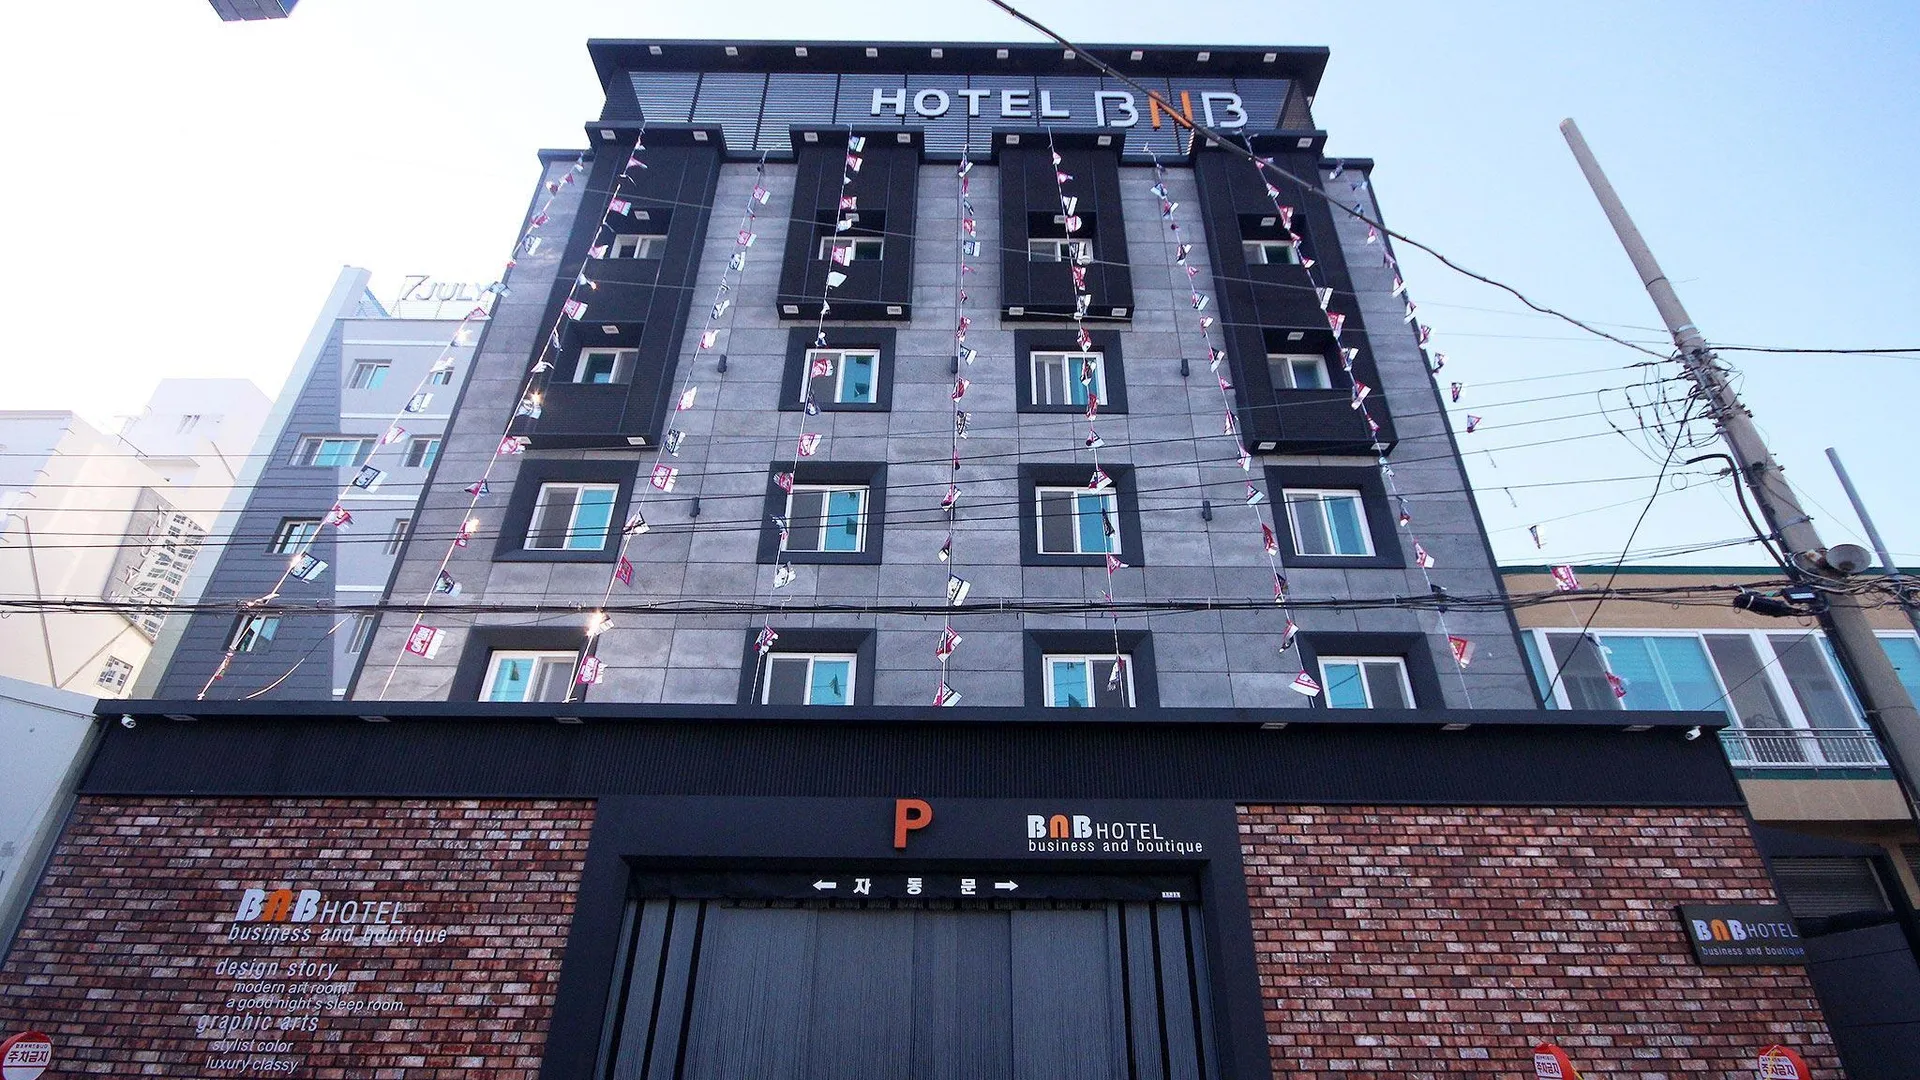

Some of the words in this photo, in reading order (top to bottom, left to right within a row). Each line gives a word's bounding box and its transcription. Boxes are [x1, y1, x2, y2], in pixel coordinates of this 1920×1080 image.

[870, 88, 1070, 118] HOTEL
[1094, 90, 1248, 129] BNB
[893, 798, 933, 848] P
[1097, 822, 1164, 839] HOTEL
[1028, 839, 1095, 852] business
[1103, 840, 1129, 852] and
[1136, 840, 1203, 854] boutique
[319, 900, 404, 924] HOTEL
[228, 924, 311, 942] business
[320, 926, 355, 942] and
[362, 926, 448, 944] boutique
[1746, 923, 1798, 938] HOTEL
[1702, 946, 1743, 956] business
[1746, 946, 1761, 955] and
[1765, 946, 1805, 956] boutique
[215, 957, 278, 978] design
[288, 960, 338, 979] story
[232, 980, 285, 994] modern
[288, 981, 308, 994] art
[226, 999, 235, 1008] a
[236, 997, 273, 1011] good
[325, 997, 364, 1013] sleep
[196, 1011, 272, 1034] graphic
[279, 1013, 319, 1031] arts
[212, 1036, 254, 1054] stylist
[257, 1036, 293, 1053] color
[8, 1050, 49, 1063] 주차금지
[205, 1056, 251, 1072] luxury
[252, 1055, 299, 1074] classy
